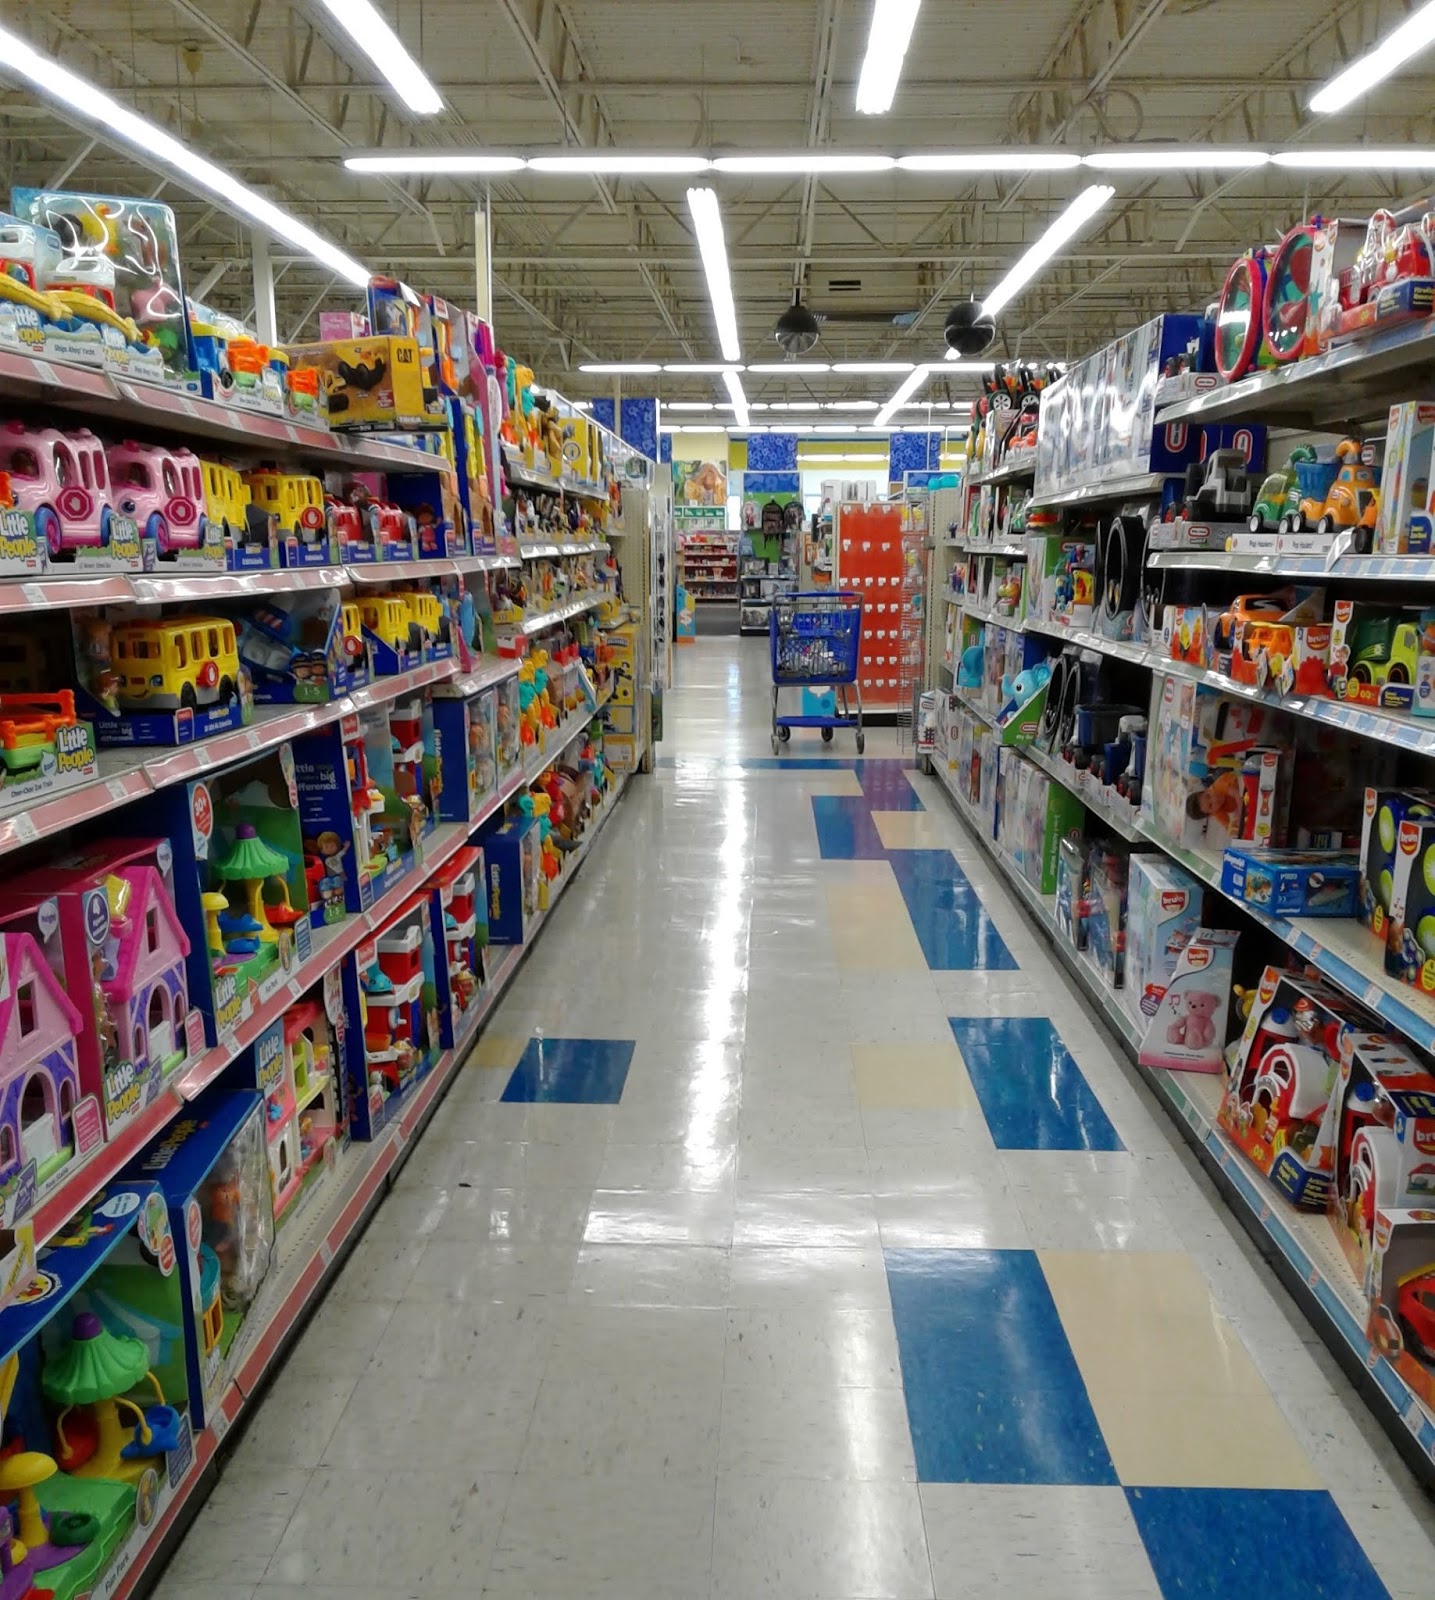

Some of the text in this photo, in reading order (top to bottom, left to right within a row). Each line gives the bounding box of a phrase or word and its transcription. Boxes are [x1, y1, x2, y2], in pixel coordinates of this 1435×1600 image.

[15, 307, 39, 326] ttle
[19, 328, 46, 346] ople
[397, 348, 413, 363] CAT
[0, 508, 29, 537] Little
[112, 518, 134, 542] Little
[0, 536, 38, 562] People
[111, 539, 139, 563] People
[1308, 634, 1329, 643] bruin
[304, 686, 320, 697] 1-5
[58, 726, 88, 753] Little
[58, 746, 94, 774] People
[320, 772, 336, 783] big
[1162, 895, 1185, 904] bruin
[328, 907, 340, 917] 1-5
[1188, 952, 1209, 961] bruin
[215, 976, 237, 1010] Little
[259, 1034, 280, 1069] Little
[106, 1063, 135, 1101] Little
[106, 1082, 142, 1126] People
[105, 1552, 130, 1593] Fun Park
